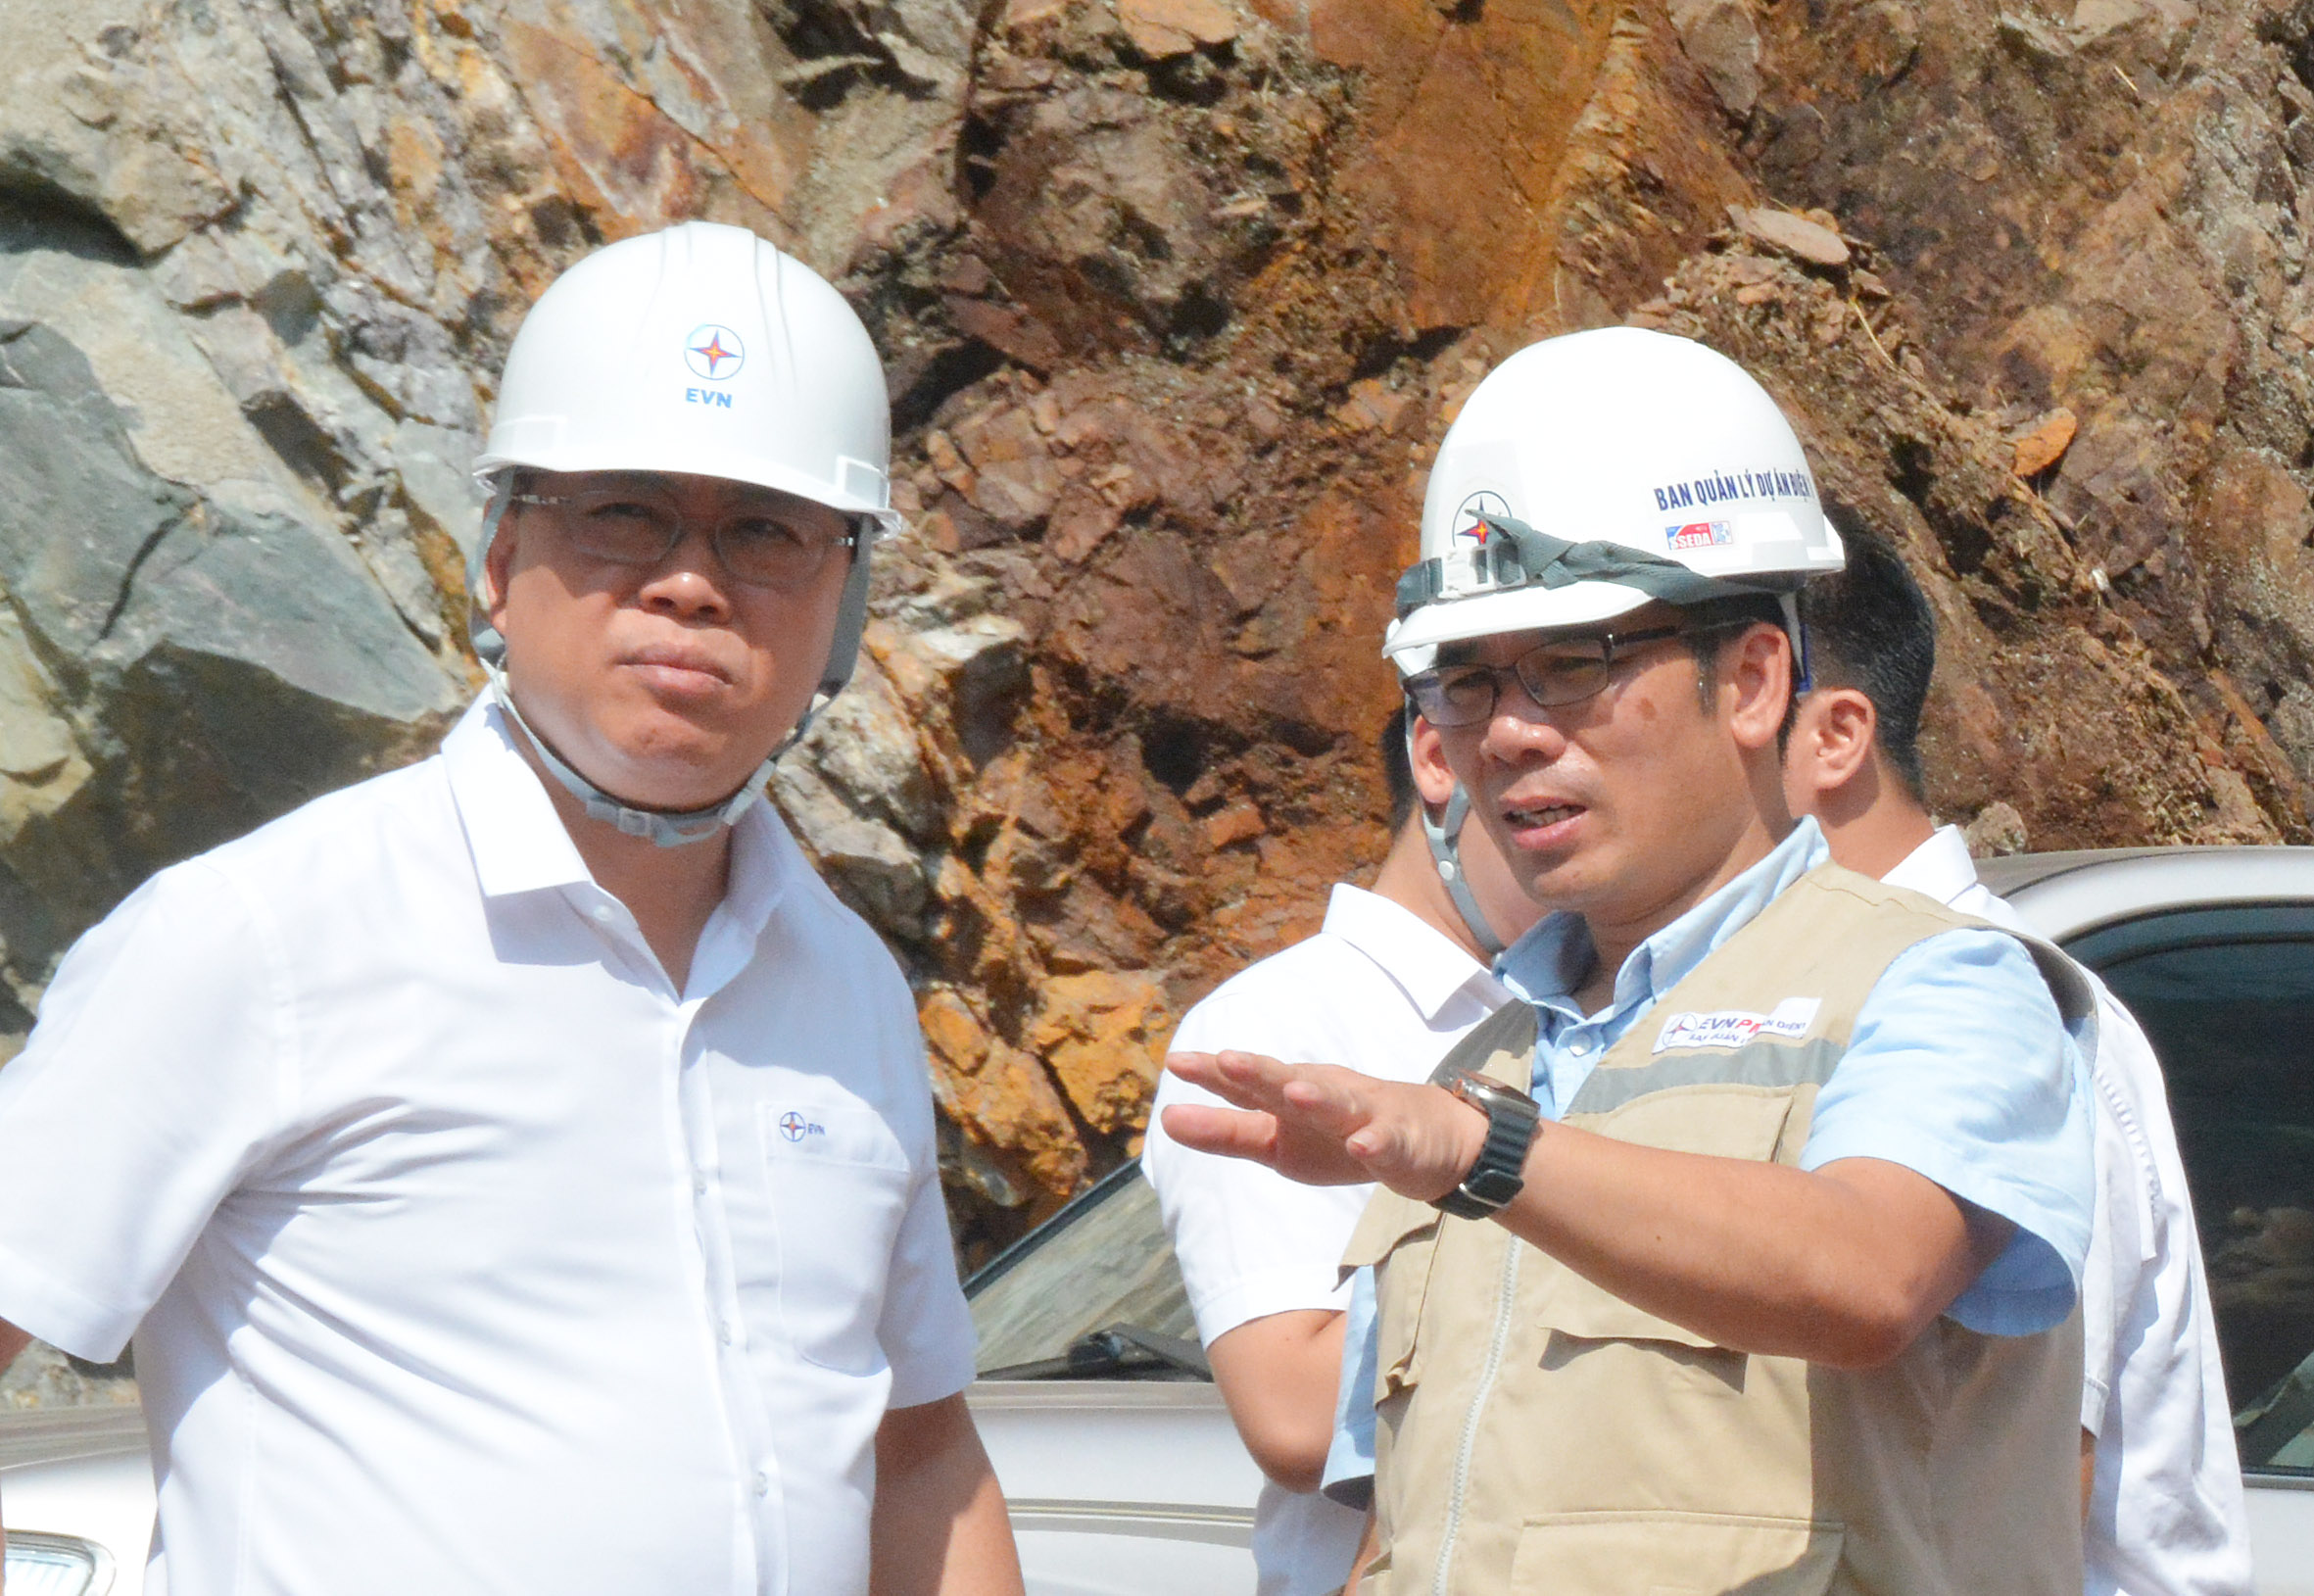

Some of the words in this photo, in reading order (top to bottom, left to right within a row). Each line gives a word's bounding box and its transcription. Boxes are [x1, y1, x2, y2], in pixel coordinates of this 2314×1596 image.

[686, 388, 733, 409] EVN
[1654, 482, 1694, 511] BAN
[1694, 469, 1739, 507] QUẢN
[1737, 468, 1756, 498] LÝ
[1755, 469, 1775, 502] DỰ
[1773, 467, 1792, 497] ÁN
[1668, 532, 1711, 549] SSEDA
